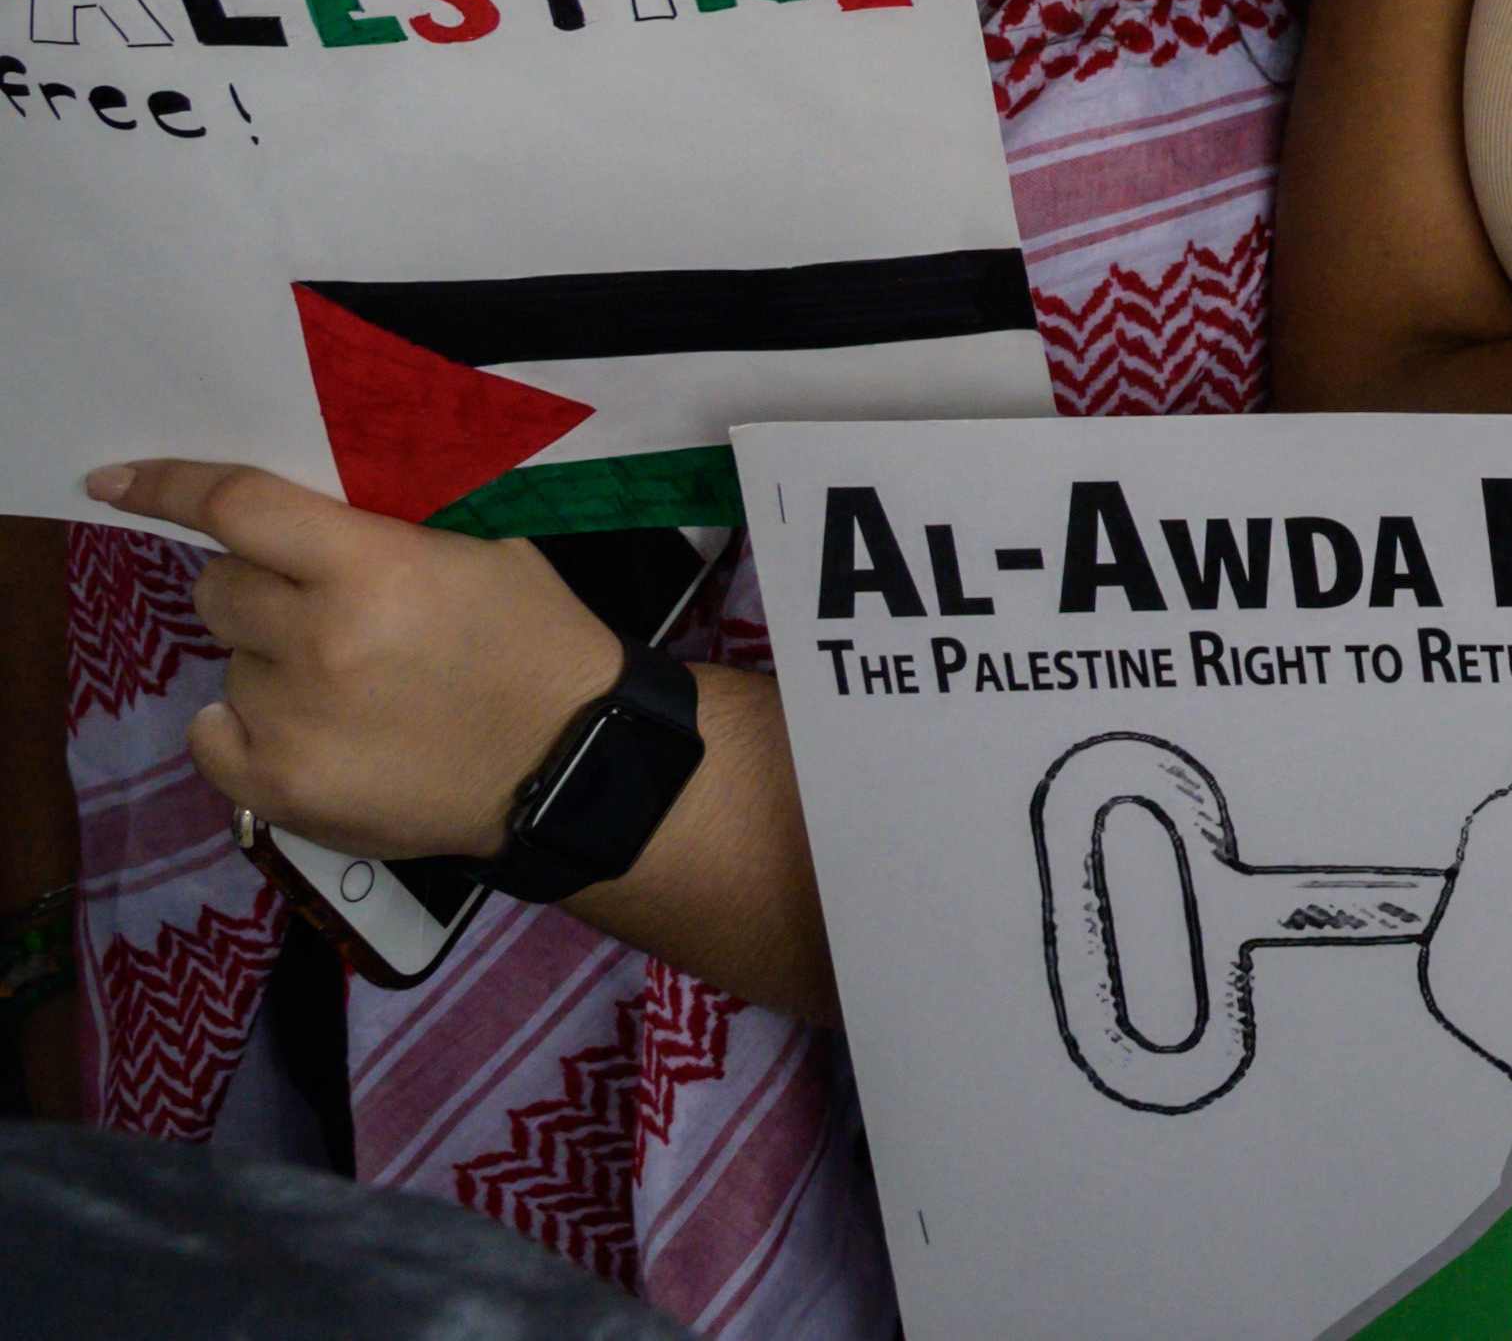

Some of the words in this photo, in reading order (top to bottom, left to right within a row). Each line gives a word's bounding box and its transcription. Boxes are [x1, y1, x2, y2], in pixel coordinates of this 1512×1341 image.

[0, 54, 262, 146] free!
[817, 639, 920, 697] THE
[934, 634, 1179, 695] PALESTINE
[1187, 629, 1333, 688] RIGHT
[1344, 641, 1404, 686] TO
